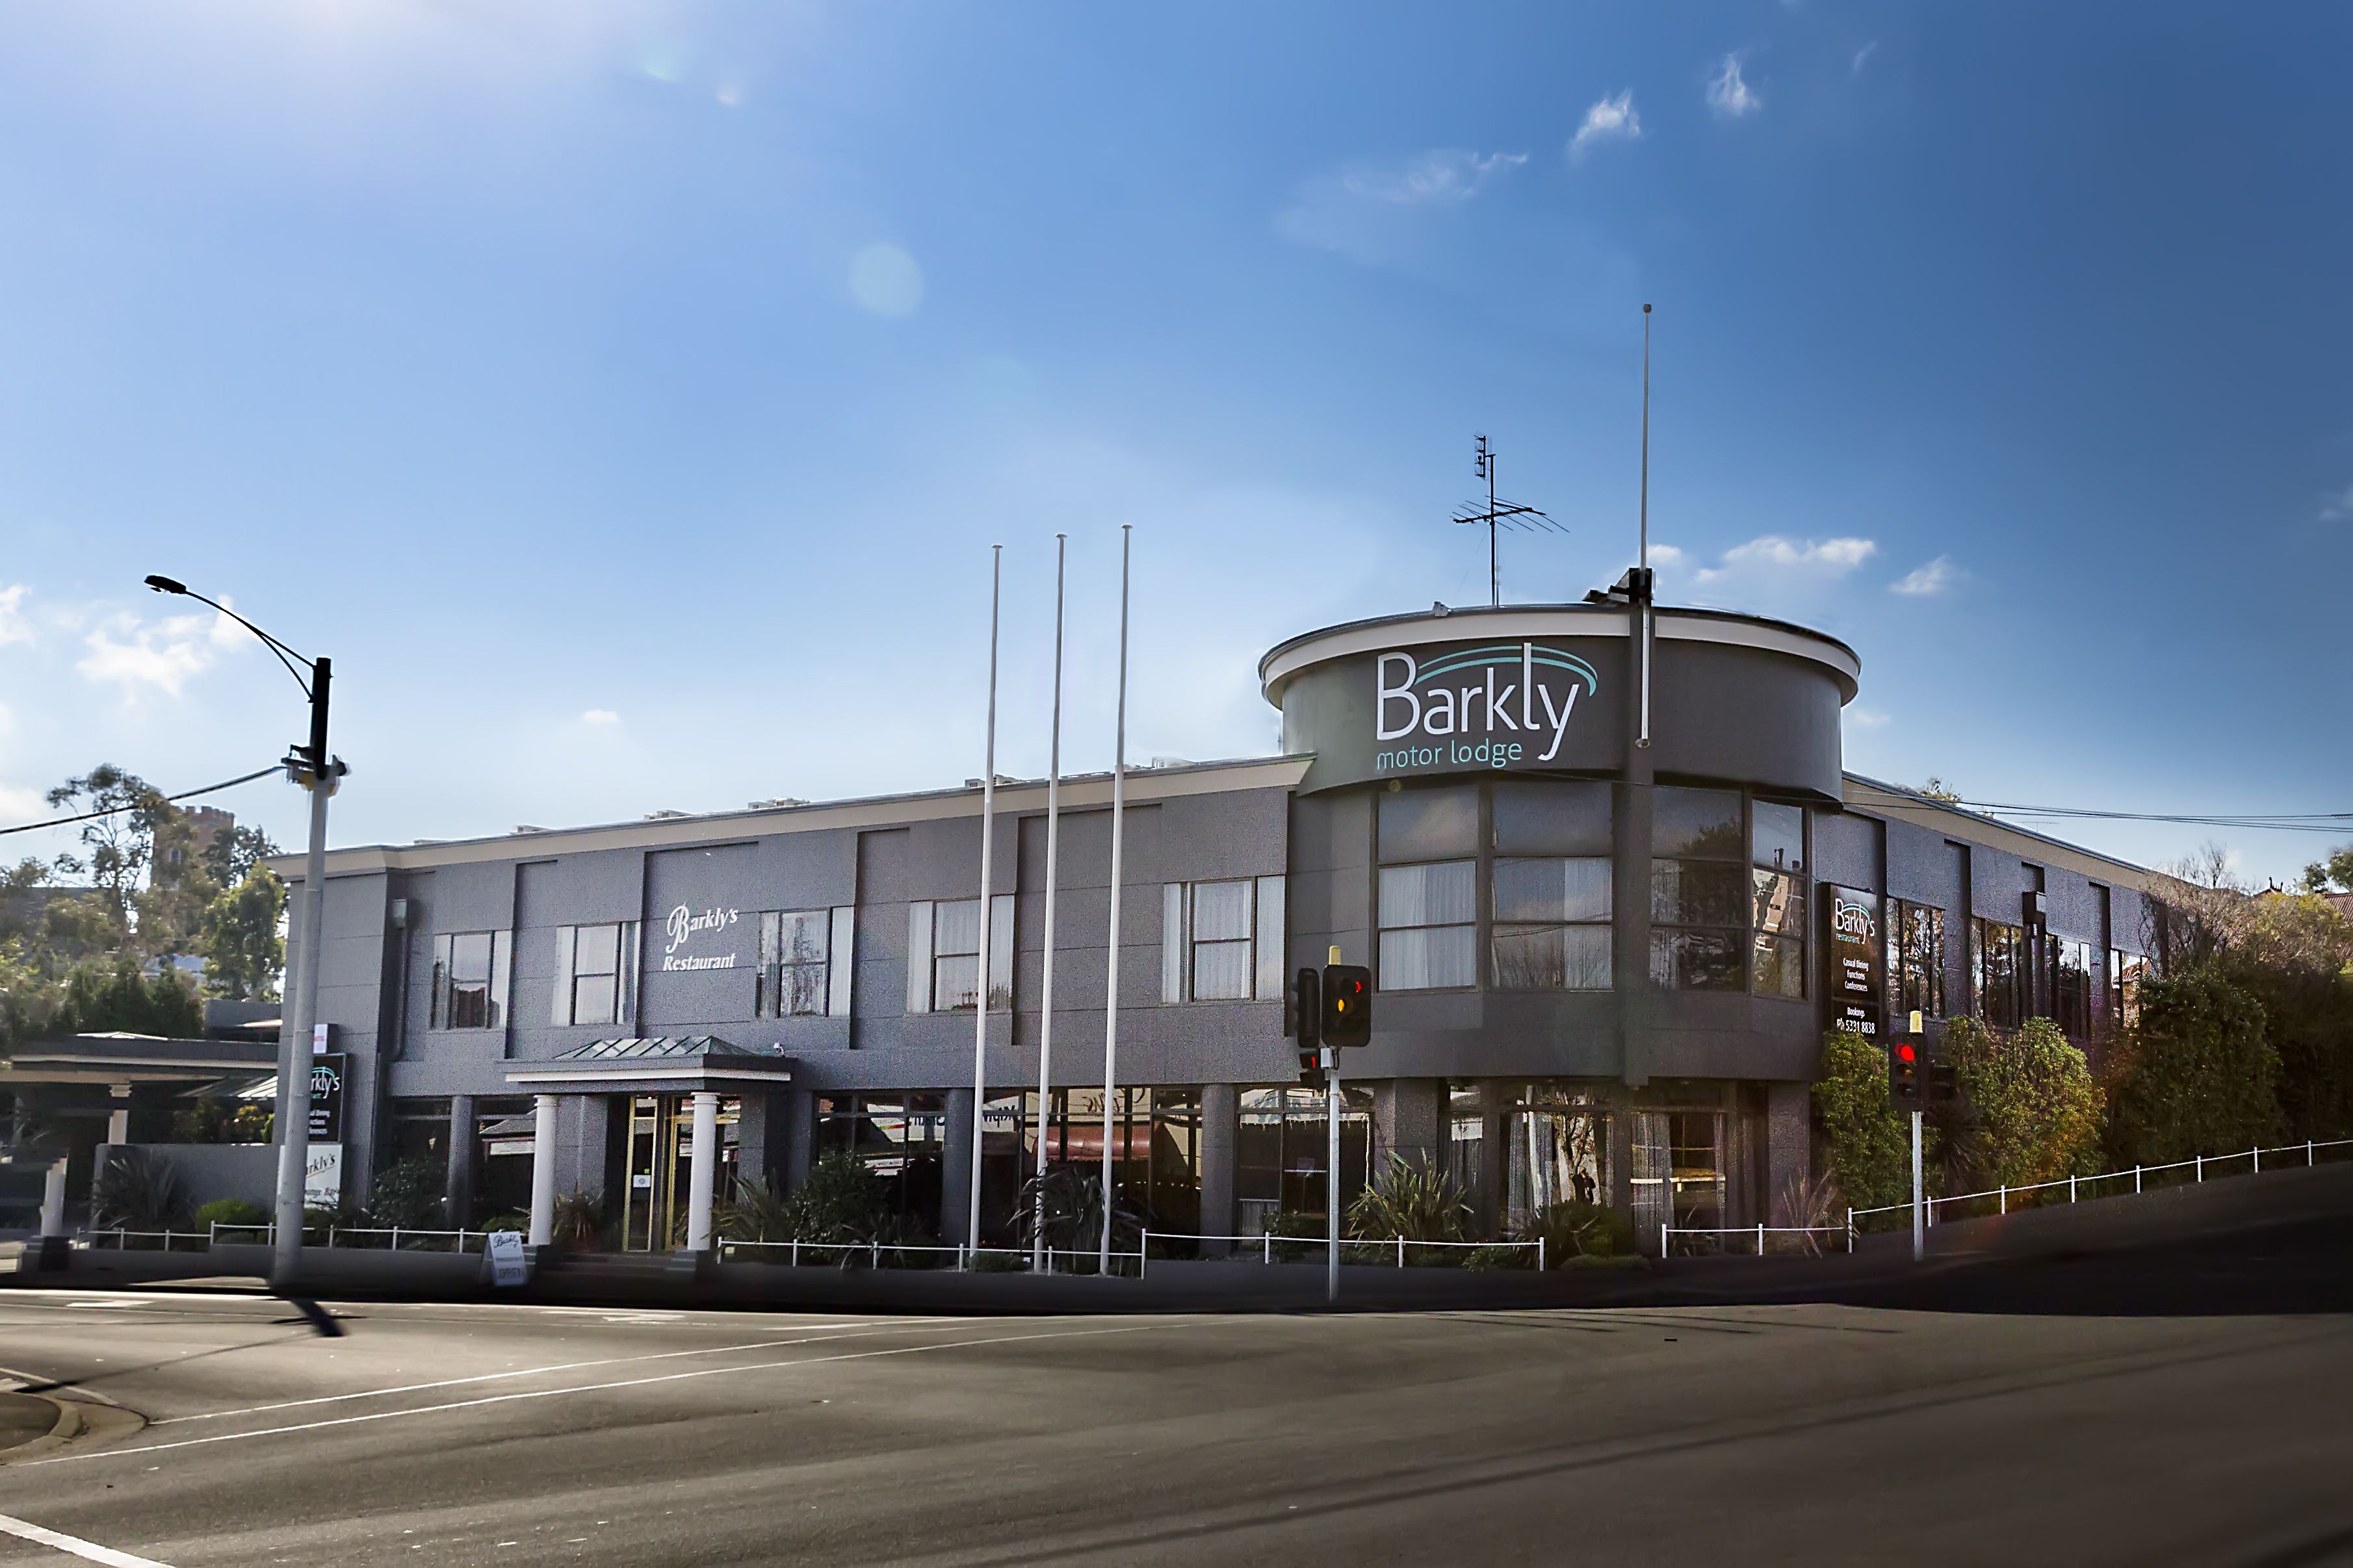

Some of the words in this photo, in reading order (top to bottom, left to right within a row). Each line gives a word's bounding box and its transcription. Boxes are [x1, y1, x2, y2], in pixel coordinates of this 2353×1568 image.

[1376, 642, 1580, 761] Barkly
[1377, 744, 1442, 770] motor
[1451, 738, 1522, 769] lodge
[665, 901, 738, 953] Barkly's
[663, 953, 736, 971] Restaurant
[1843, 957, 1856, 968] Casual
[1856, 959, 1869, 971] Dining
[1847, 970, 1866, 980] Functions
[1844, 981, 1868, 992] Conferences
[1847, 1007, 1865, 1018] Bookings
[1861, 1021, 1875, 1034] 8838
[311, 1066, 340, 1098] rkly's
[306, 1153, 335, 1172] rkly's
